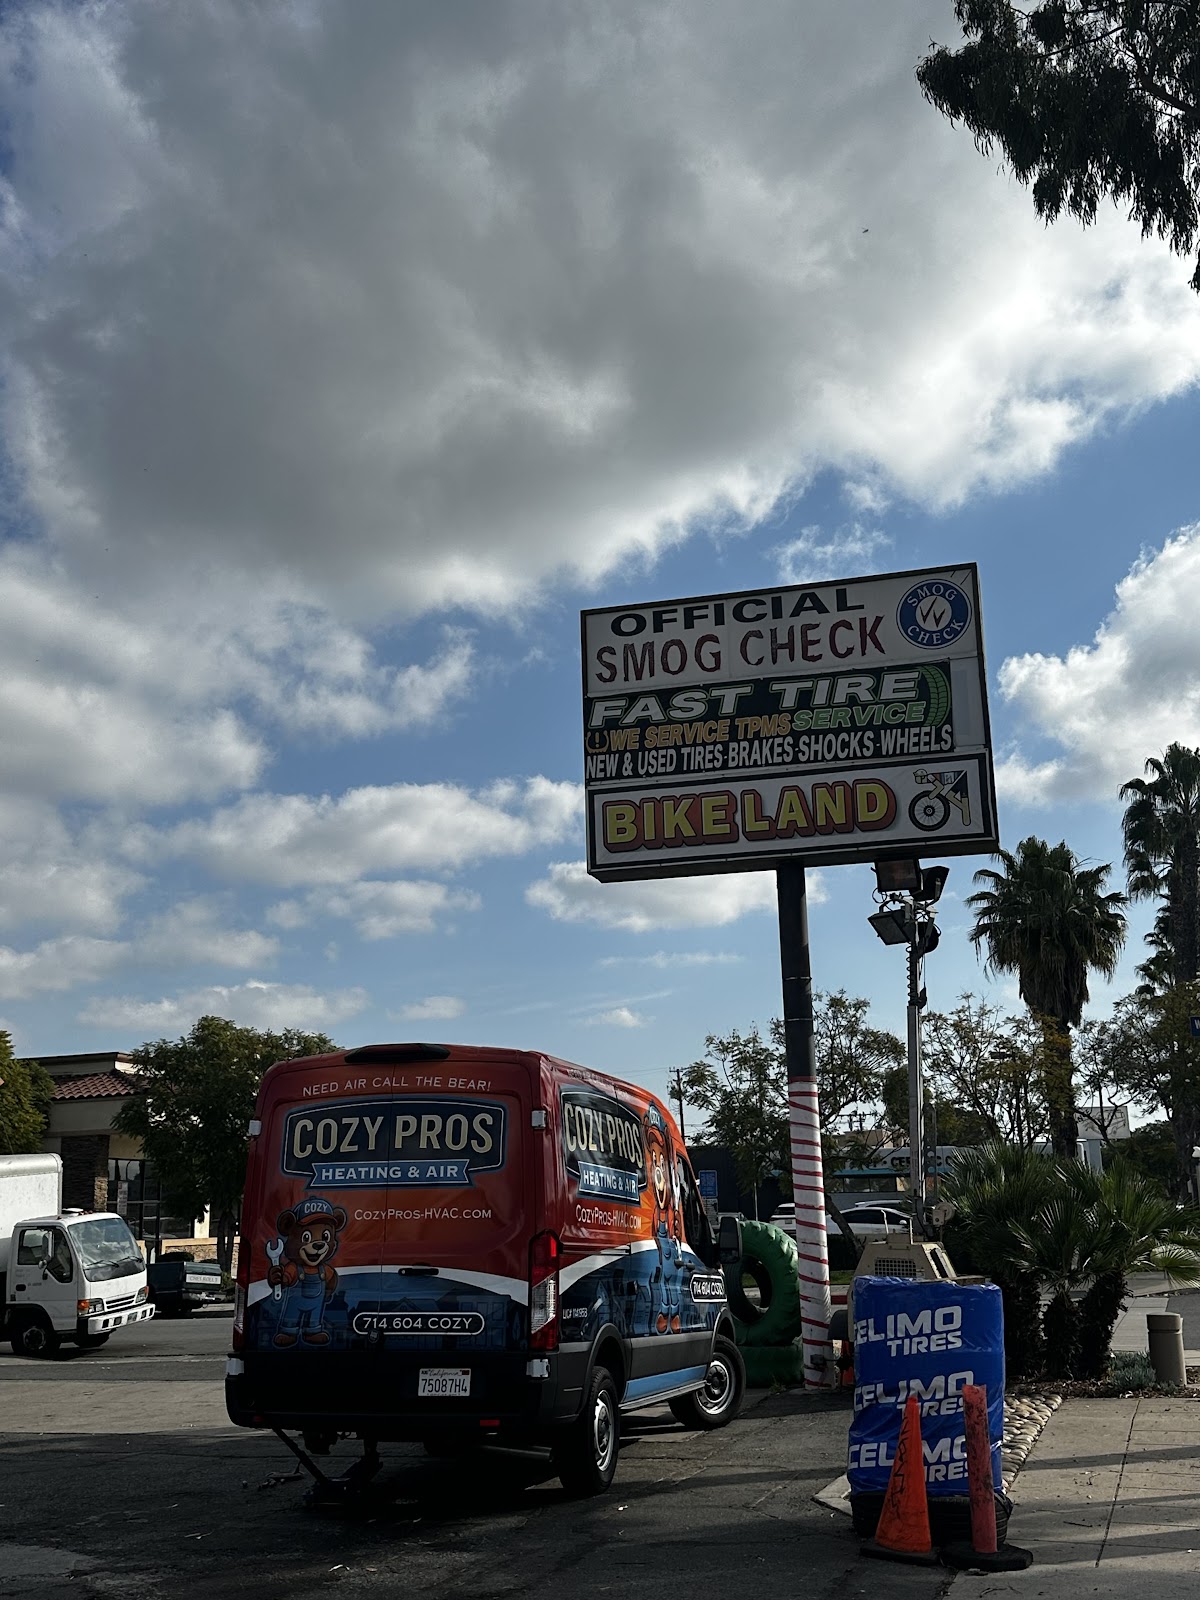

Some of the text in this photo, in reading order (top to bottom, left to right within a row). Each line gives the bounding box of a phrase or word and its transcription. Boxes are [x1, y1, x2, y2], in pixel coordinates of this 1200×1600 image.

[610, 588, 865, 637] OFFICIAL
[907, 583, 964, 645] SMOG CHECK
[596, 615, 886, 683] SMOG CHECK
[589, 671, 921, 728] FAST TIRE
[793, 701, 927, 731] SERVICE
[610, 713, 792, 751] WE SERVICE TPMS
[586, 753, 618, 779] NEW
[621, 753, 634, 777] &
[637, 747, 677, 775] USED
[303, 1076, 492, 1097] NEED AIR CALL THE BEAR!
[293, 1113, 494, 1159] COZY PROS
[564, 1102, 644, 1169] COZY PROS
[321, 1165, 459, 1182] HEATING & AIR
[583, 1169, 636, 1194] HEATING & AIR
[304, 1202, 329, 1214] COZY
[362, 1317, 473, 1329] 714 604 COZY
[886, 1331, 963, 1358] TIRES
[421, 1378, 468, 1393] 75087H4
